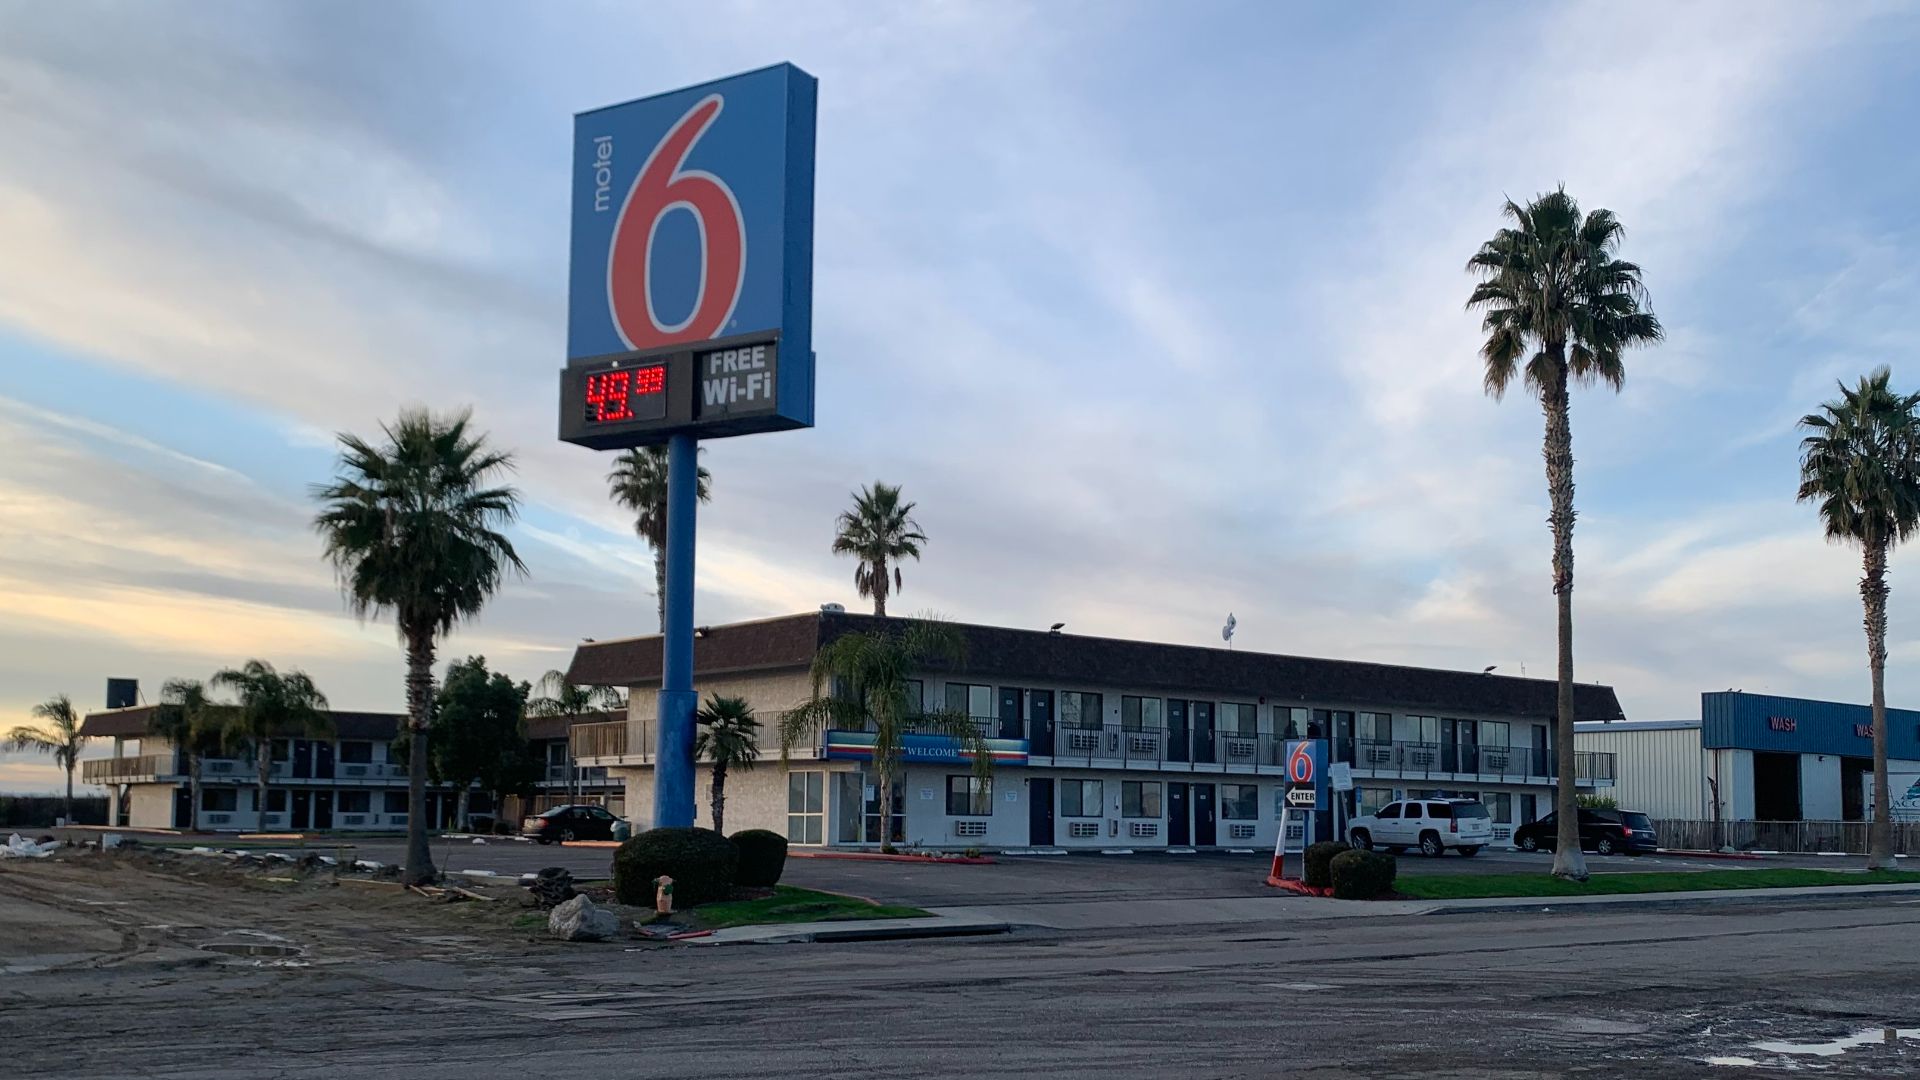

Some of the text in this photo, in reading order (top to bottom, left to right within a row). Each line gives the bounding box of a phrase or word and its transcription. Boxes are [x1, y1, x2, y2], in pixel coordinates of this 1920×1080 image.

[592, 135, 613, 212] motel
[606, 93, 747, 351] 6
[710, 345, 765, 375] FREE
[703, 371, 771, 406] Wi-Fi
[1771, 717, 1797, 731] WASH
[1856, 724, 1875, 737] WAS
[907, 747, 958, 757] WELCOME
[1290, 741, 1313, 782] 6
[1291, 792, 1315, 801] ENTER
